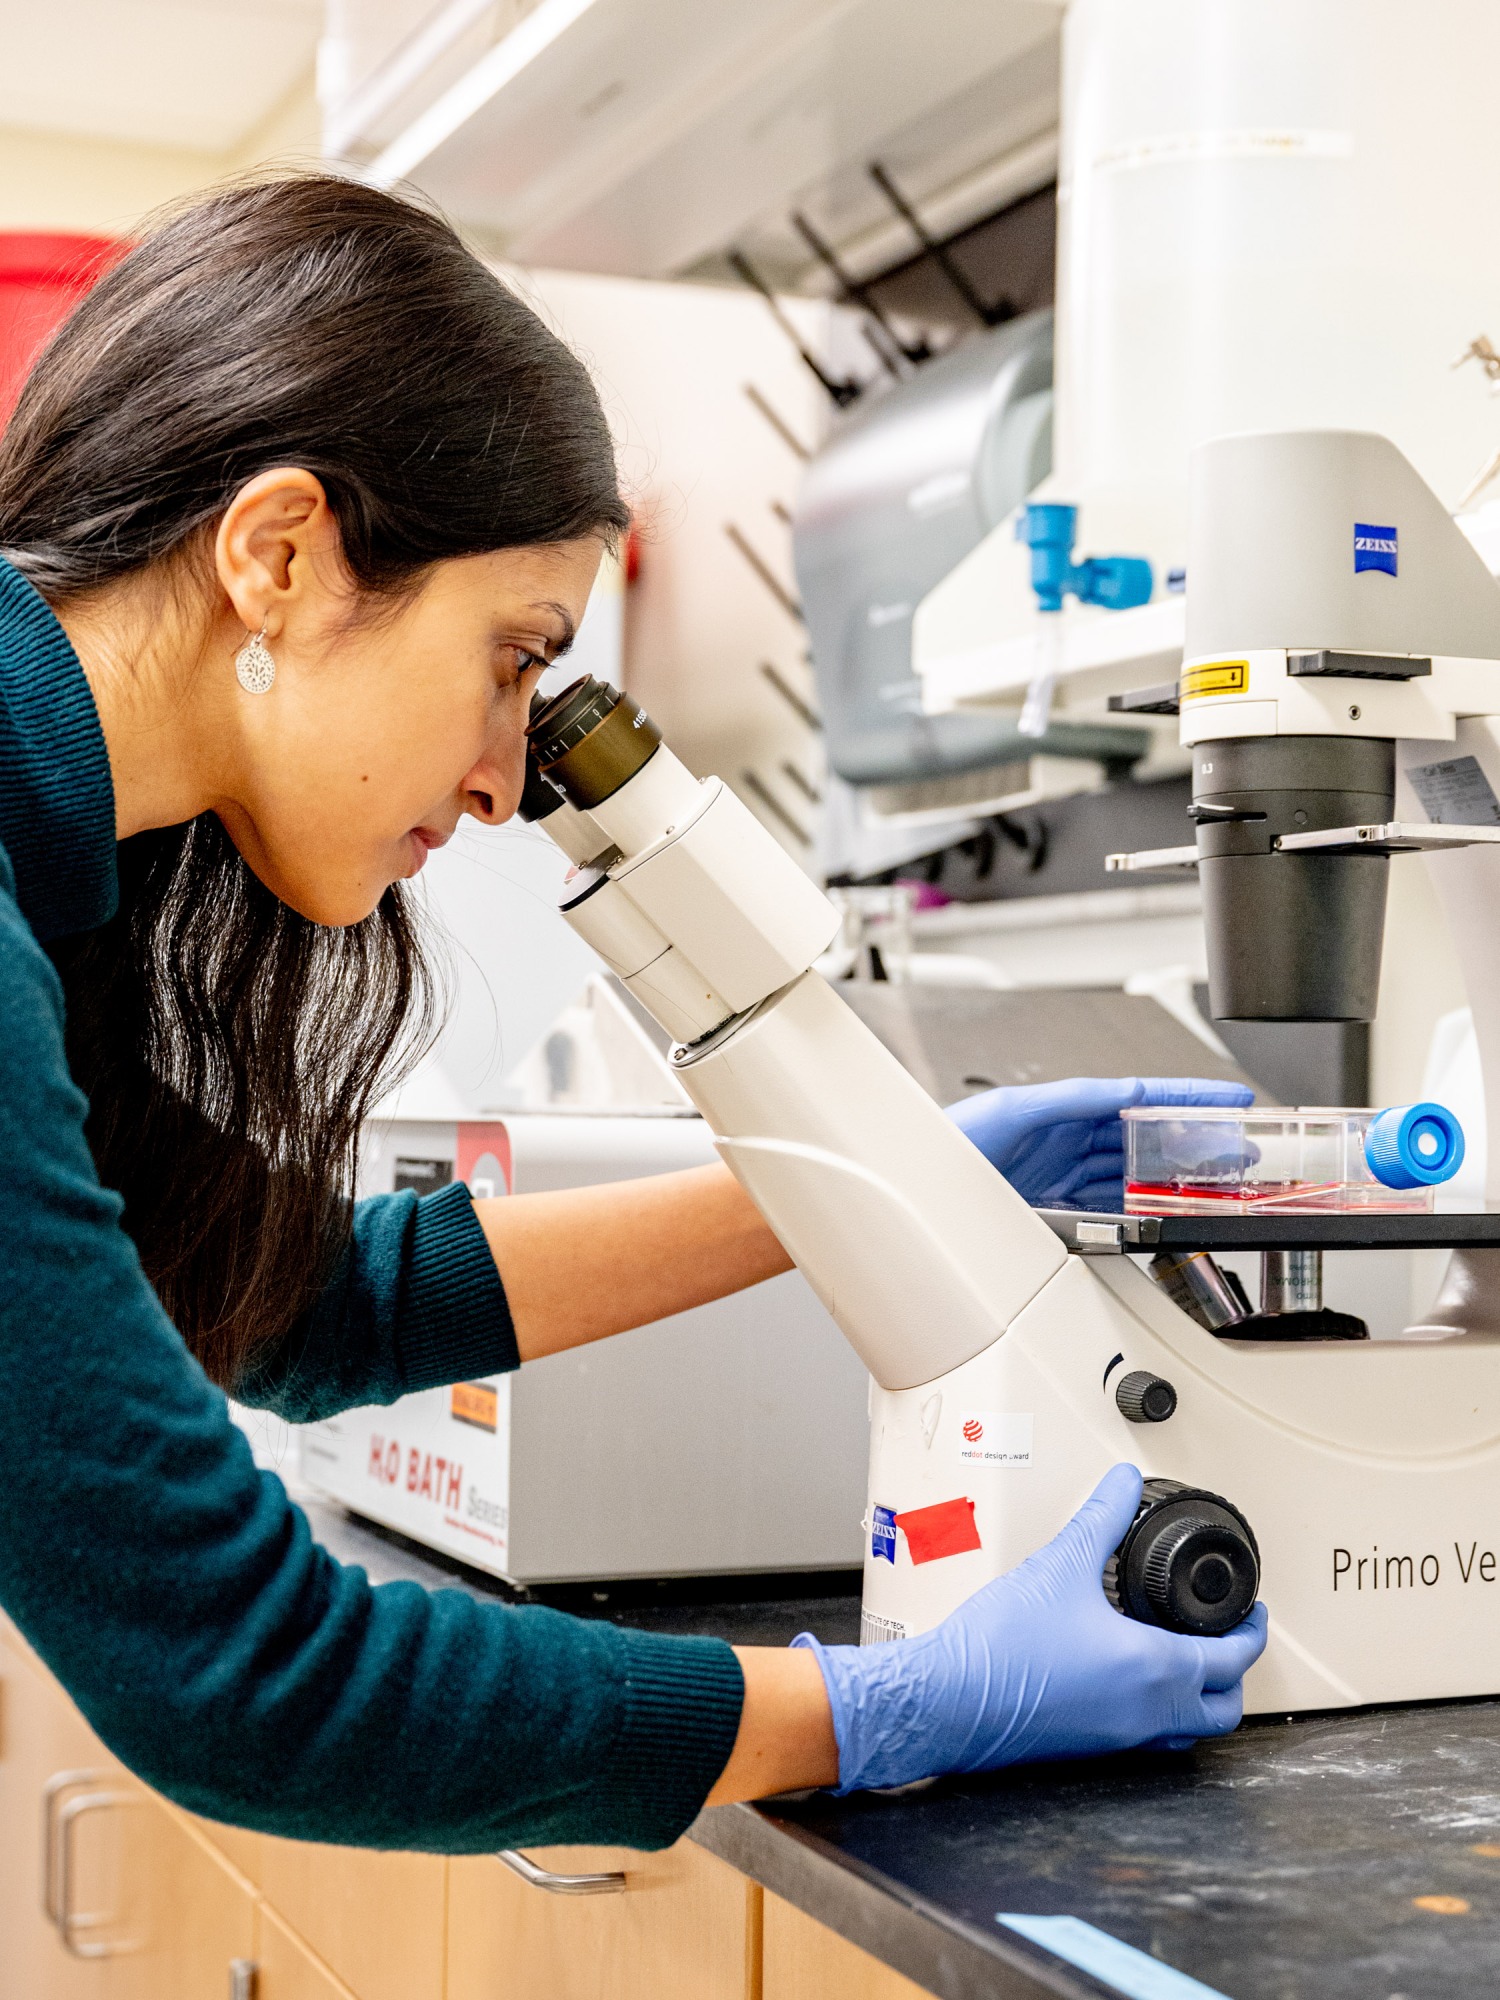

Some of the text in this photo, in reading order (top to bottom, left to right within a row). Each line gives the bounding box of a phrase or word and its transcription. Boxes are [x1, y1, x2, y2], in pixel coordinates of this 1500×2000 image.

[1355, 537, 1397, 553] ZEISS
[984, 1452, 1007, 1460] design
[406, 1446, 463, 1511] BATH
[873, 1521, 896, 1540] ZEISS
[1333, 1541, 1497, 1592] Primo Ve
